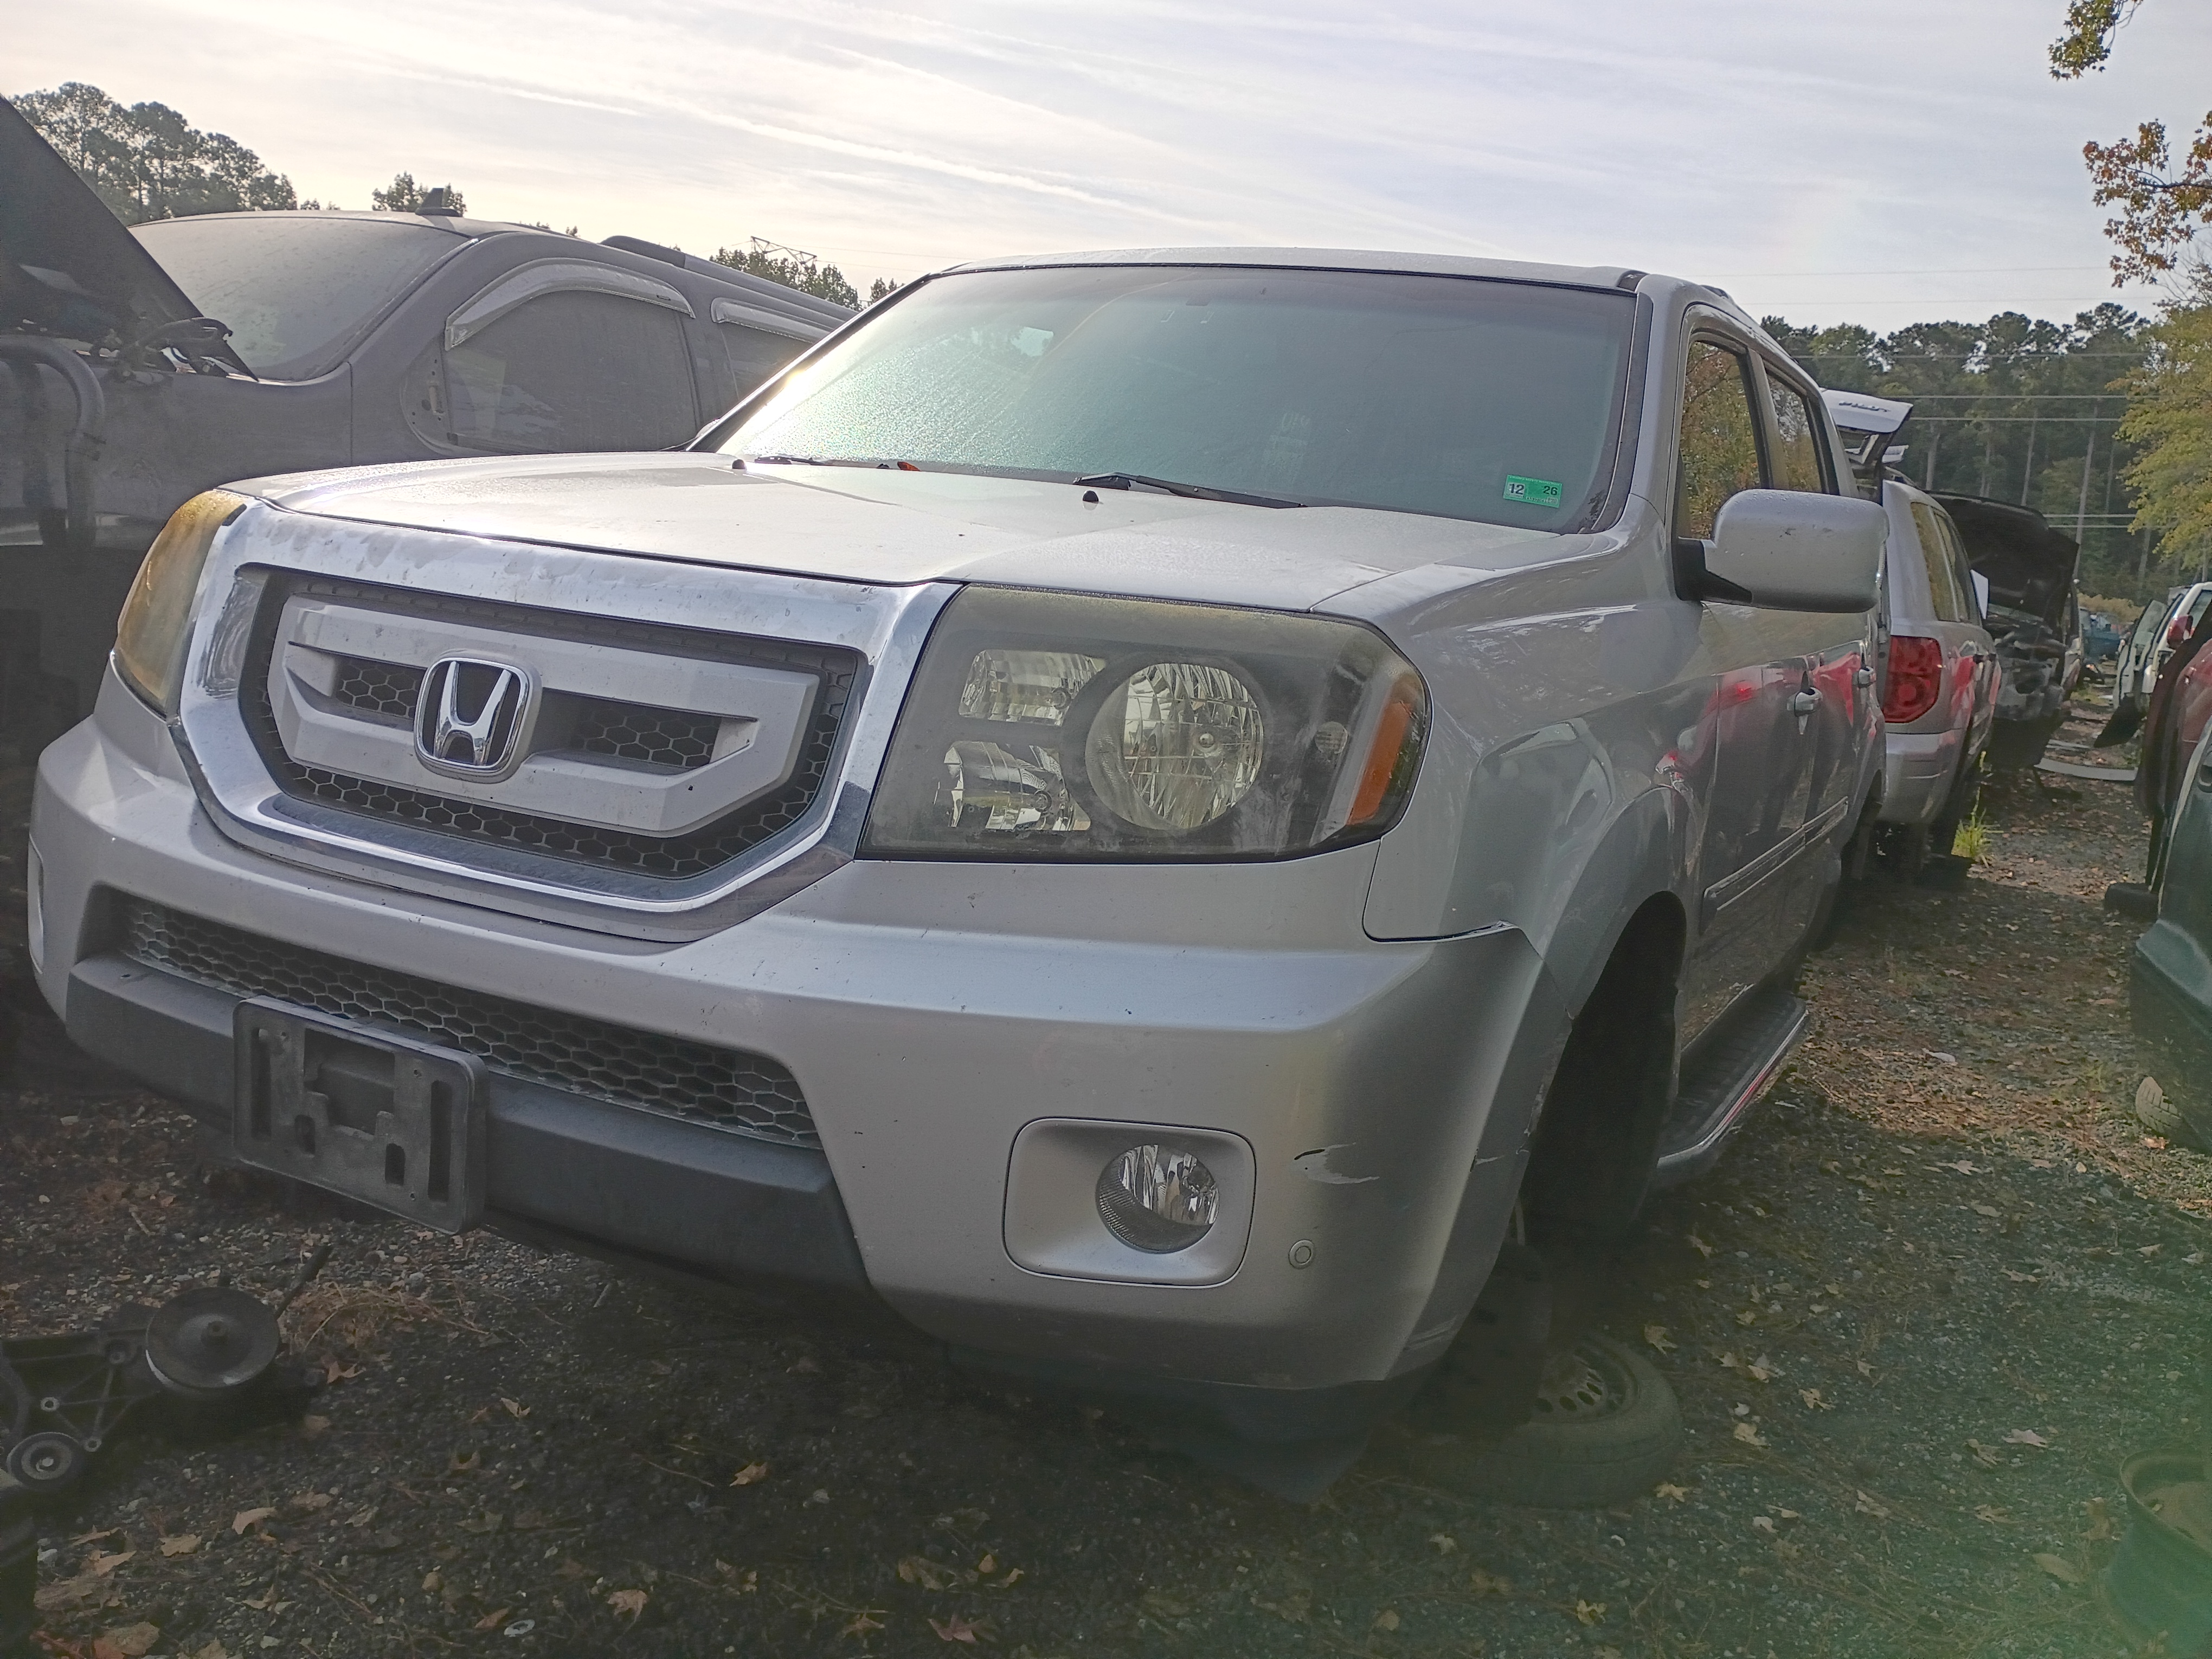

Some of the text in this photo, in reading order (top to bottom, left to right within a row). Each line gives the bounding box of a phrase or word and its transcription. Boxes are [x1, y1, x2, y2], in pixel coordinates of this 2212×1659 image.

[1838, 401, 1891, 412] PILOT
[1509, 483, 1558, 496] 12 26
